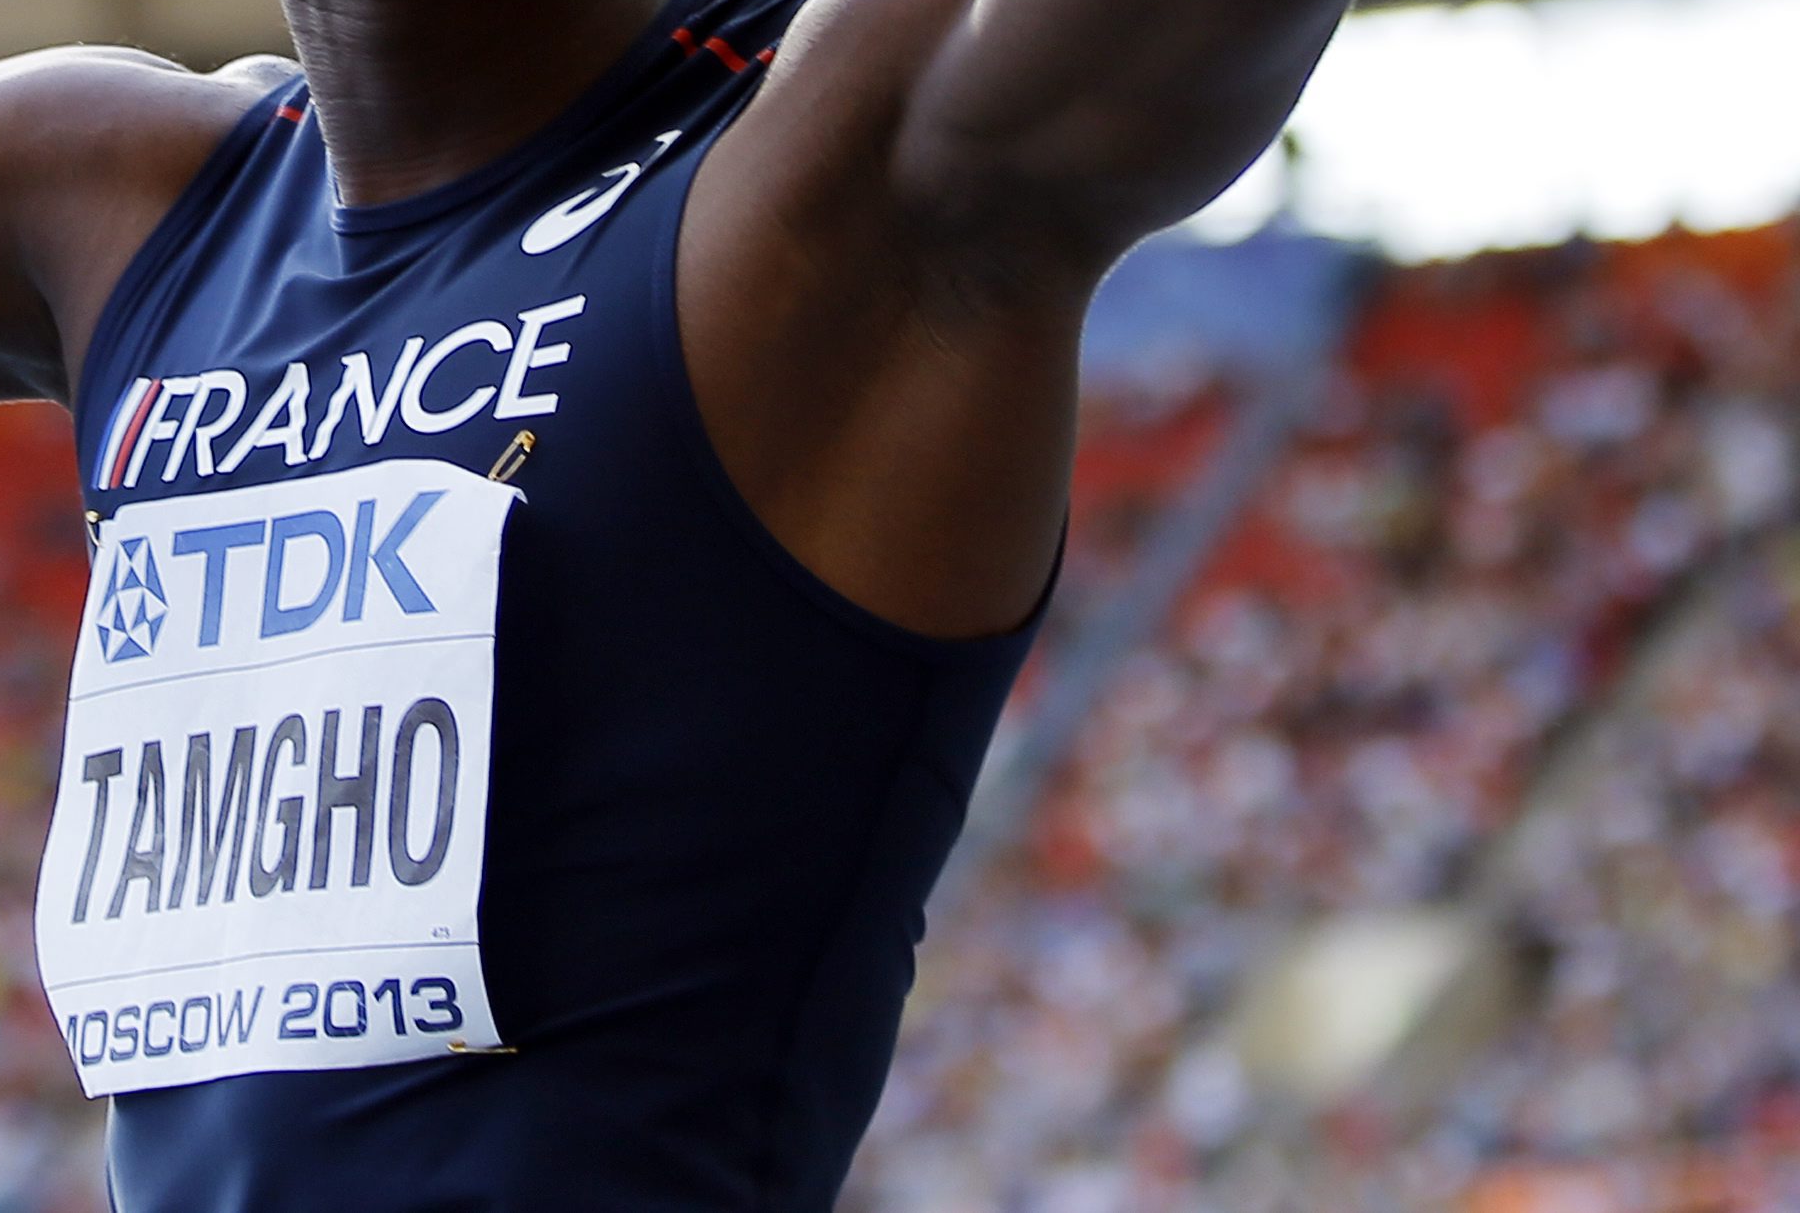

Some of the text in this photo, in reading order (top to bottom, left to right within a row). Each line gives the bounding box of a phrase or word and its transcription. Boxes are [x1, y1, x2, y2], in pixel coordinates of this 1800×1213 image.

[123, 294, 587, 489] FRANCE
[173, 490, 449, 646] TDK
[71, 697, 459, 924] TAMGHO
[277, 977, 464, 1039] 2013
